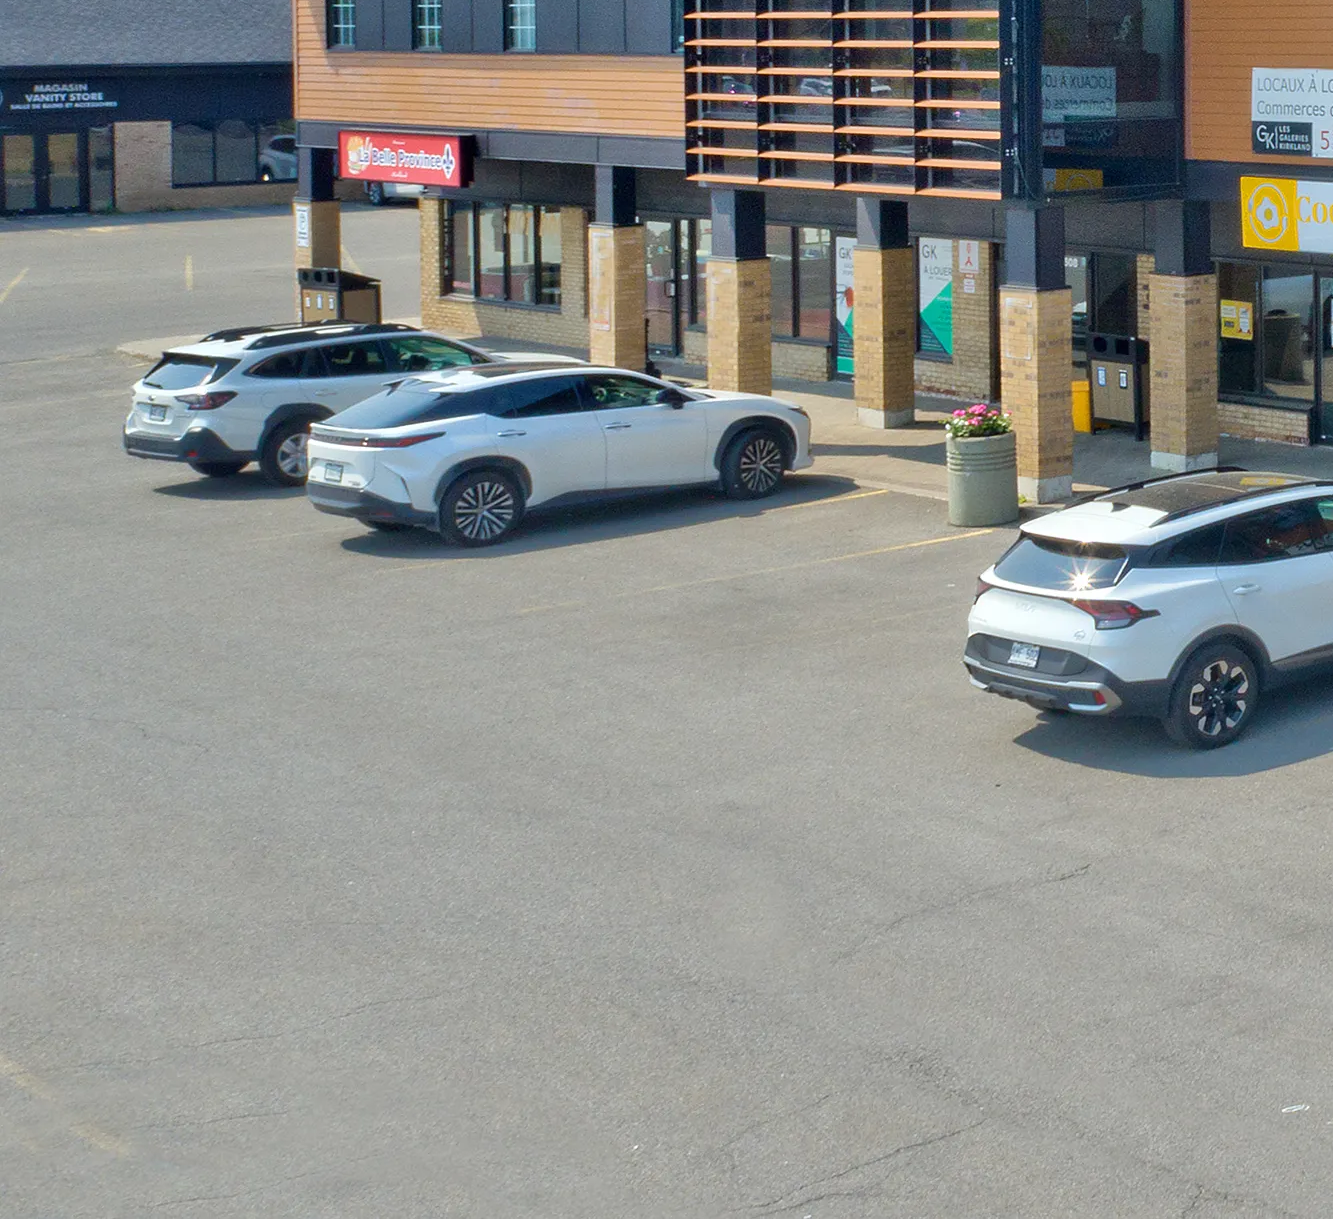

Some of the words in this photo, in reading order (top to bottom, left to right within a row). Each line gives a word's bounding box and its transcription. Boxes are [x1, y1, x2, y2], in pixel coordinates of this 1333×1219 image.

[33, 84, 88, 92] MAGASIN
[1257, 77, 1305, 93] LOCAUX
[1308, 74, 1318, 93] À
[25, 93, 67, 102] VANITY
[69, 92, 104, 101] STORE
[1257, 100, 1326, 117] Commerces
[1279, 133, 1309, 143] GALERIES
[1279, 142, 1311, 152] KIRKLAND
[359, 147, 370, 165] La
[372, 148, 397, 167] Belle
[398, 149, 442, 170] Province
[921, 244, 938, 260] GK
